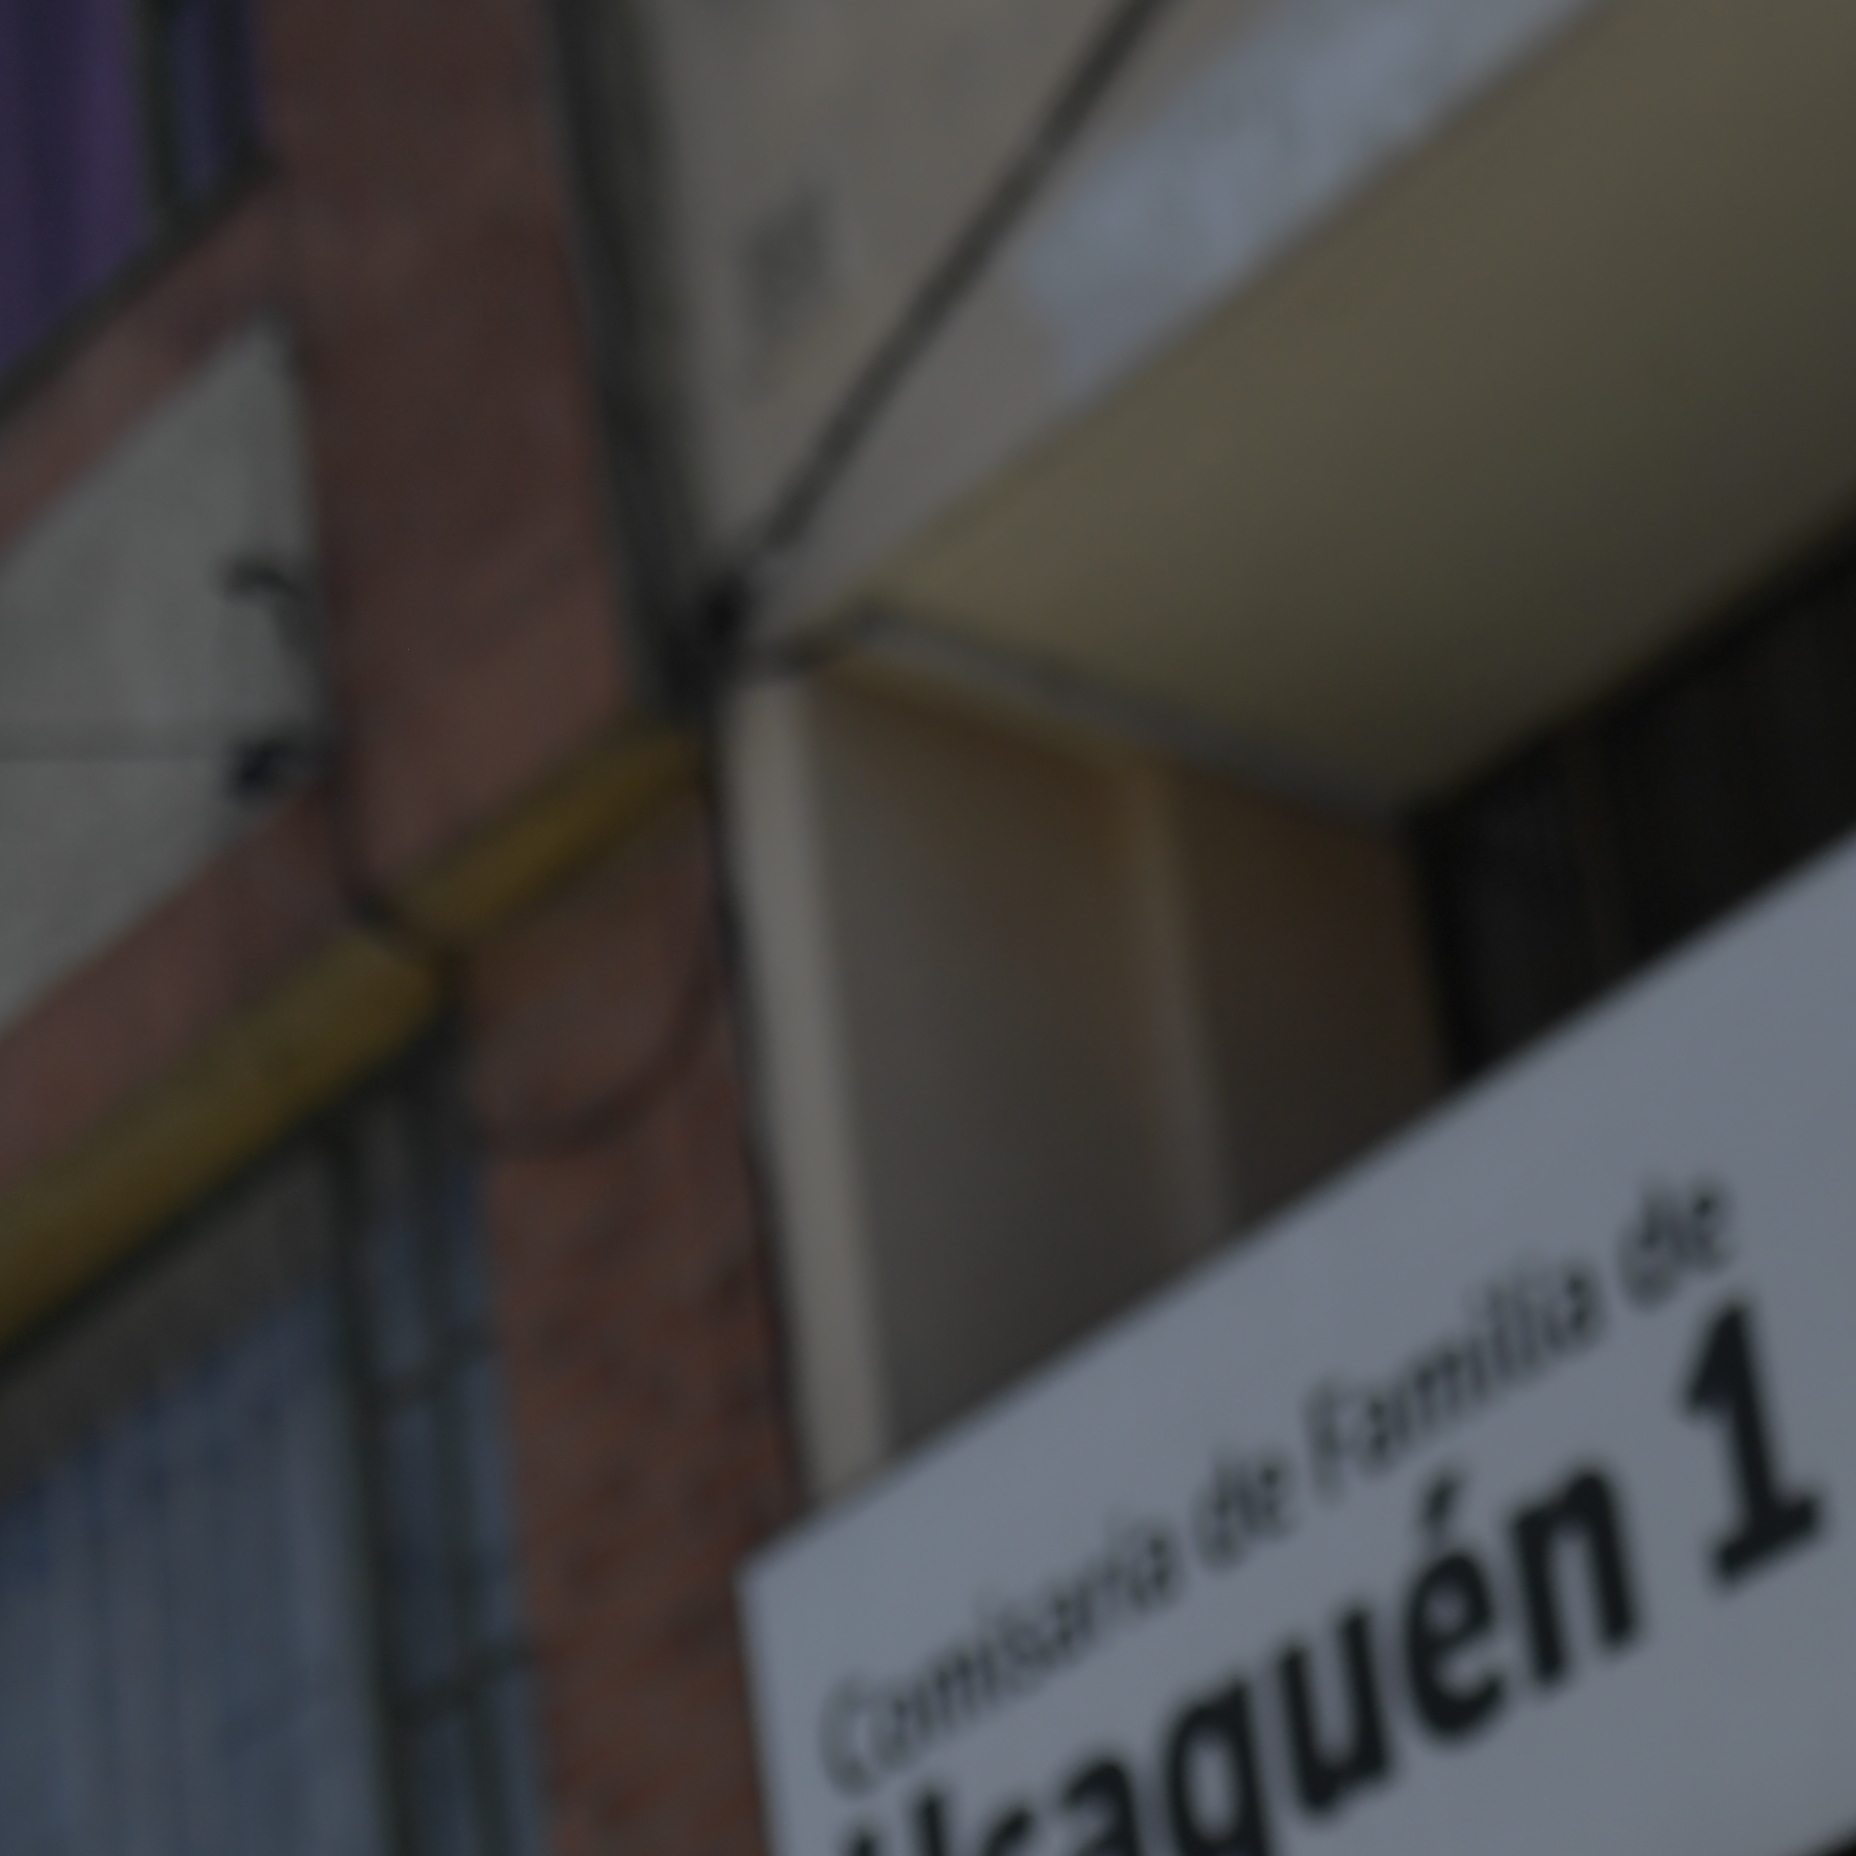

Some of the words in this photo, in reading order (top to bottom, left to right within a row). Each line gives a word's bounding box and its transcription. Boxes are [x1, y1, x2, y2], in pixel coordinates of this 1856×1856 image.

[1198, 1440, 1297, 1572] de
[1304, 1250, 1606, 1502] Familia
[1617, 1175, 1734, 1308] de
[1682, 1288, 1825, 1592] 1
